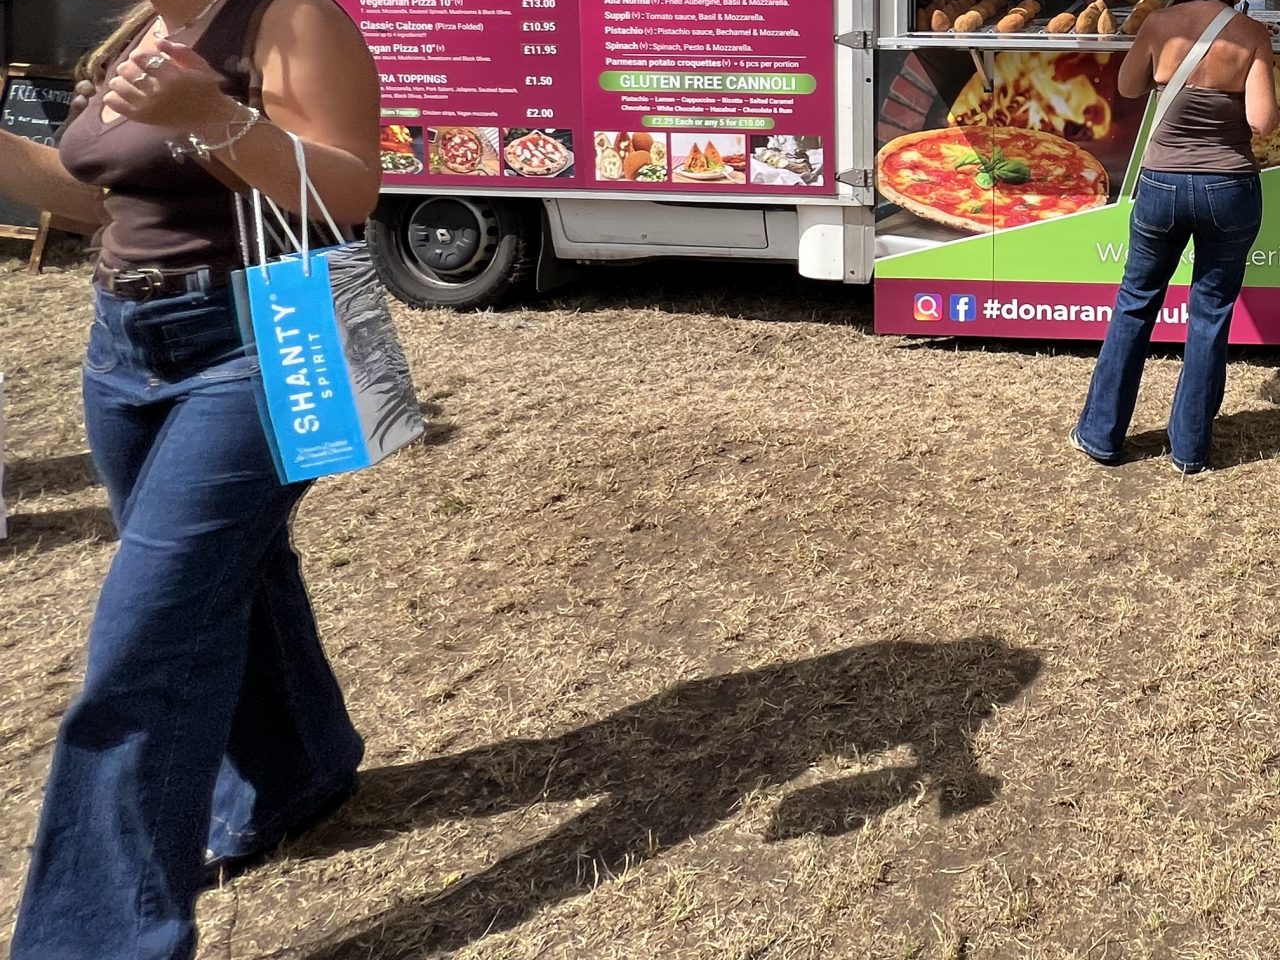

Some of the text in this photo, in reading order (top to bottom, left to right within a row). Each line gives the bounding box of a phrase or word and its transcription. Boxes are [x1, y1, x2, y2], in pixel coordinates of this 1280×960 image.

[645, 12, 674, 20] Tomato
[674, 13, 698, 21] sauce,
[698, 13, 716, 21] Basil
[360, 20, 556, 32] Classic Calzone (Pizza Folded) £10.95
[604, 26, 644, 35] Pistachio
[657, 27, 691, 35] Pistachio
[692, 28, 716, 36] sauce,
[716, 28, 752, 36] Bechamel
[367, 43, 392, 54] egan
[393, 44, 419, 53] Pizza
[523, 45, 557, 55] £11.95
[605, 41, 639, 51] Spinach
[683, 43, 705, 51] Pesto
[605, 58, 648, 66] Parmesan
[648, 58, 676, 68] potato
[676, 59, 722, 68] croquettes
[746, 61, 759, 69] pcs
[760, 61, 772, 69] per
[773, 60, 800, 68] portion
[396, 74, 448, 84] TOPPINGS
[525, 76, 553, 86] £1.50
[619, 74, 796, 91] GLUTEN FREE CANNOLI
[526, 108, 554, 119] £2.00
[738, 119, 765, 127] £10.00
[270, 303, 320, 434] SHANTY
[308, 333, 333, 399] SPIRIT
